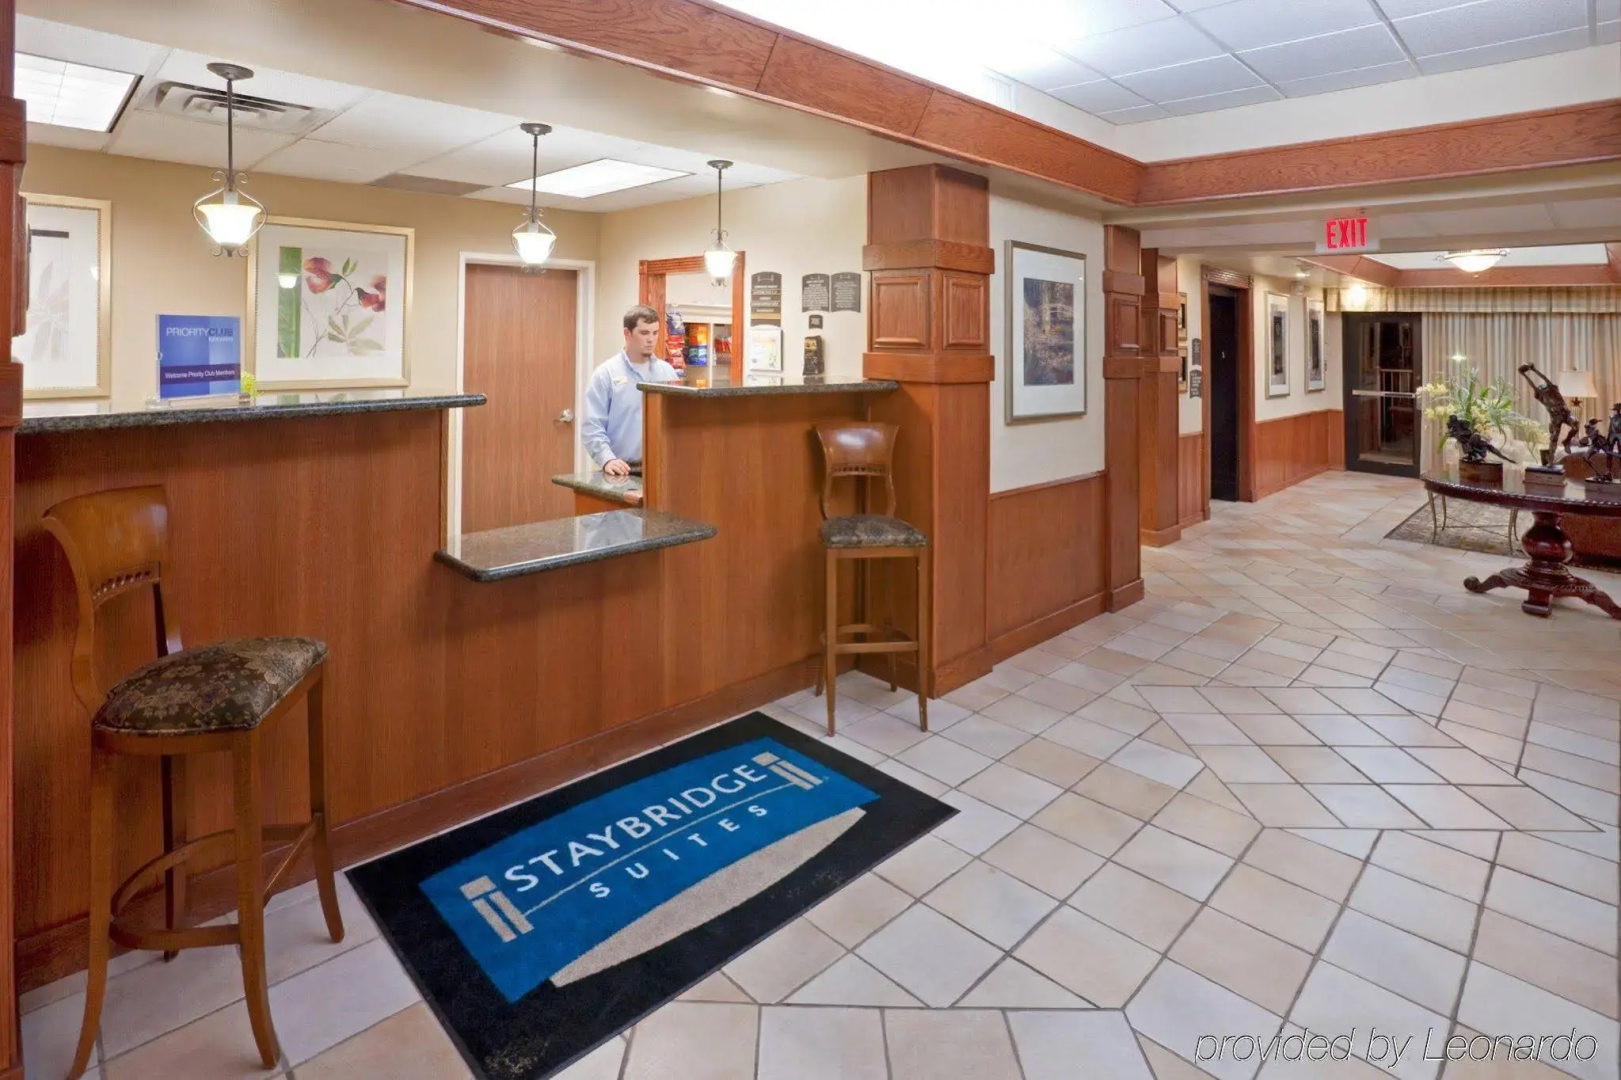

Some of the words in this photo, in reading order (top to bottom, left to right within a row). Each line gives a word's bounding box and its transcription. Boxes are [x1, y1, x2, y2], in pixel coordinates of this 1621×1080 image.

[1326, 218, 1367, 248] EXIT
[504, 764, 769, 893] STAYBRIDGE
[589, 804, 768, 898] SUITES
